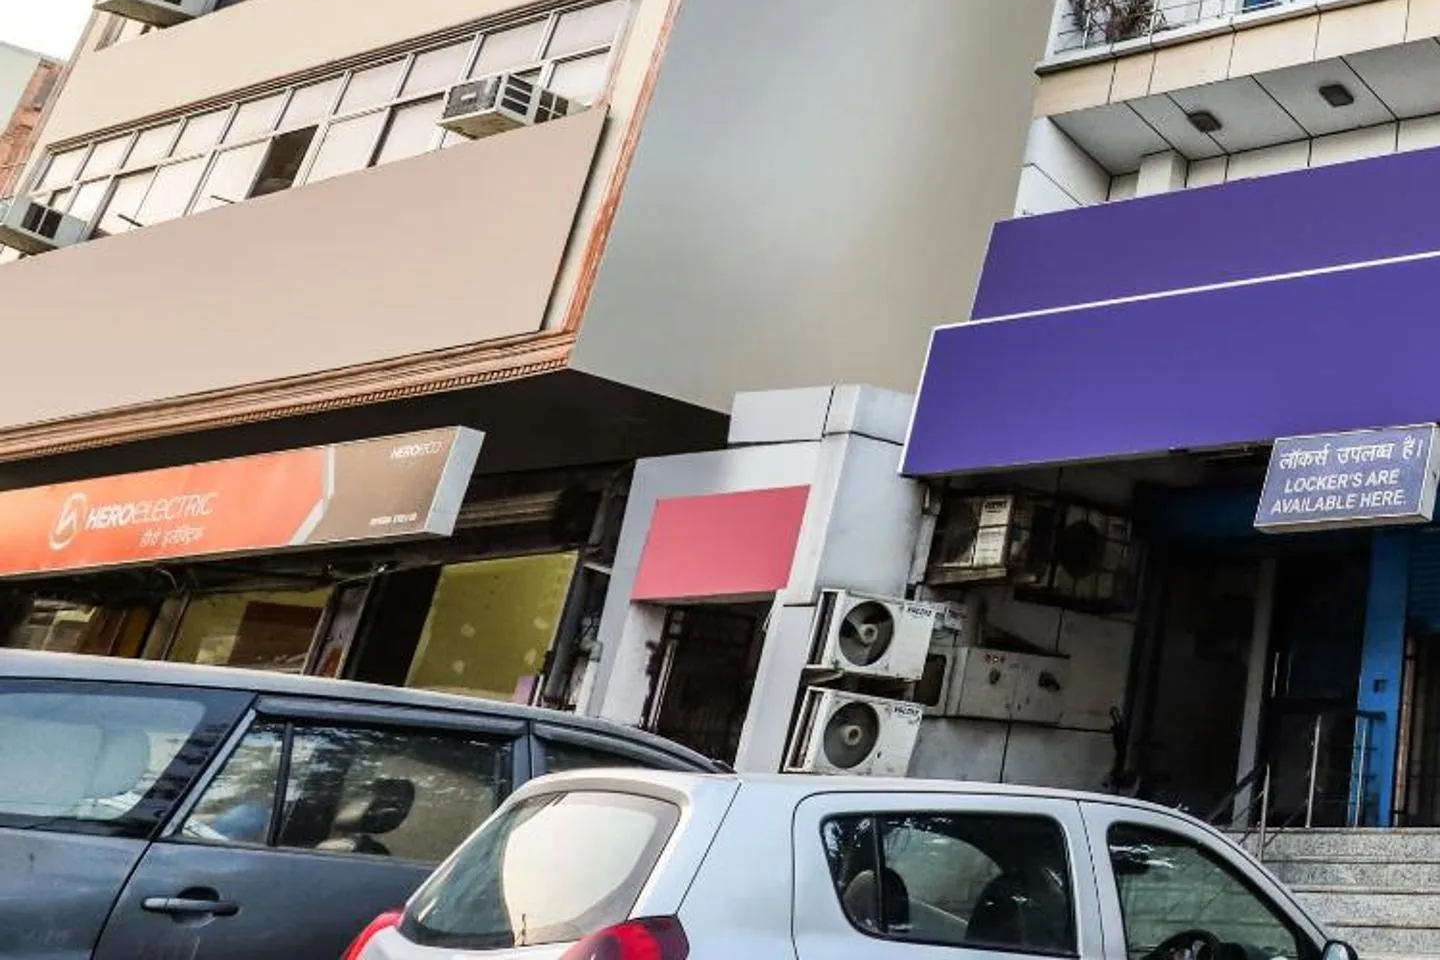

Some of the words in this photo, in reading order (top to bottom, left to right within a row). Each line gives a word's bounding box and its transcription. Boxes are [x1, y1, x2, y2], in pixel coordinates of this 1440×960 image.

[1284, 472, 1363, 494] LOCKER'S
[1365, 468, 1400, 486] ARE
[1270, 496, 1356, 516] AVAILABLE
